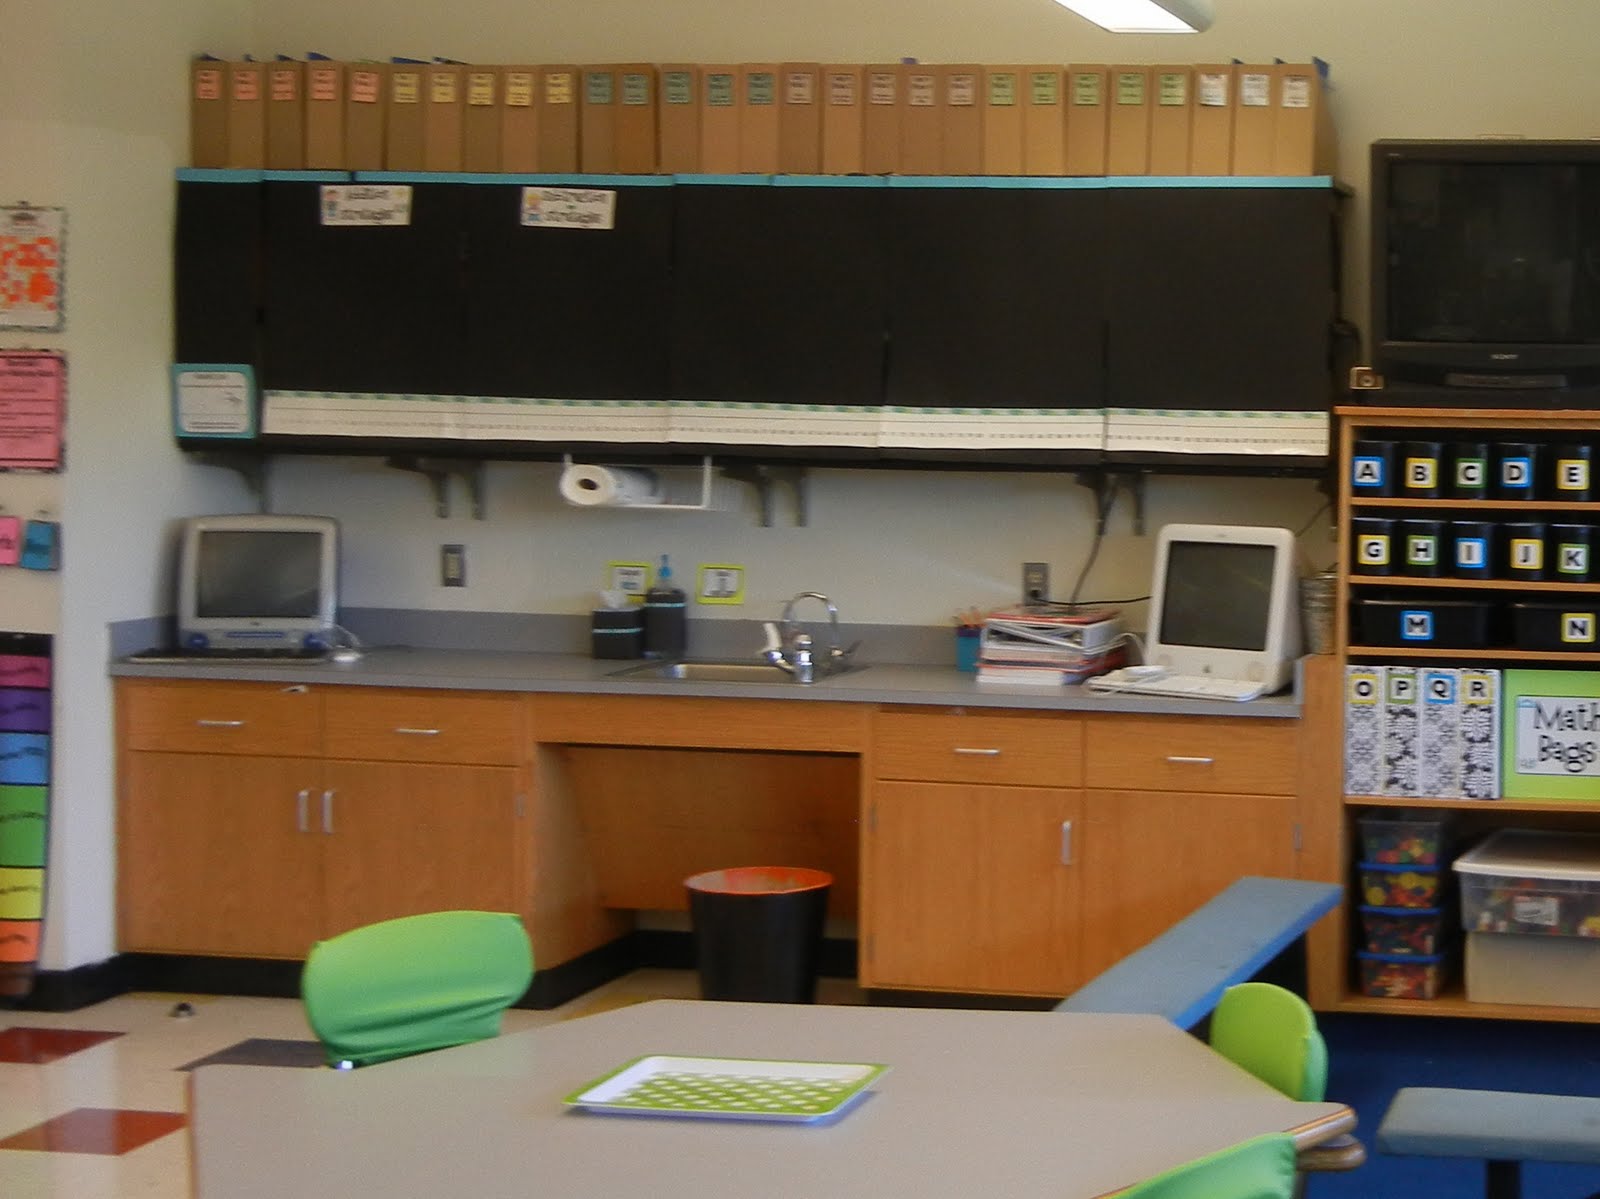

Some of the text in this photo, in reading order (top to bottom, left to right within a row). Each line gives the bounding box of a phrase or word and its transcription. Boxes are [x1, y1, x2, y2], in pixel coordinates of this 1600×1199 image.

[1360, 463, 1376, 479] A
[1414, 465, 1427, 481] B
[1463, 465, 1477, 481] C
[1508, 465, 1522, 481] D
[1567, 466, 1579, 483] E
[1366, 542, 1380, 558] G
[1414, 542, 1430, 558] H
[1465, 545, 1473, 561] I
[1521, 545, 1530, 563] J
[1565, 550, 1581, 566] K
[1408, 617, 1426, 633] M
[1570, 620, 1587, 637] N
[1356, 680, 1372, 697] O
[1396, 680, 1409, 696] P
[1432, 679, 1447, 697] Q
[1470, 681, 1484, 697] R
[1538, 734, 1598, 773] Bags
